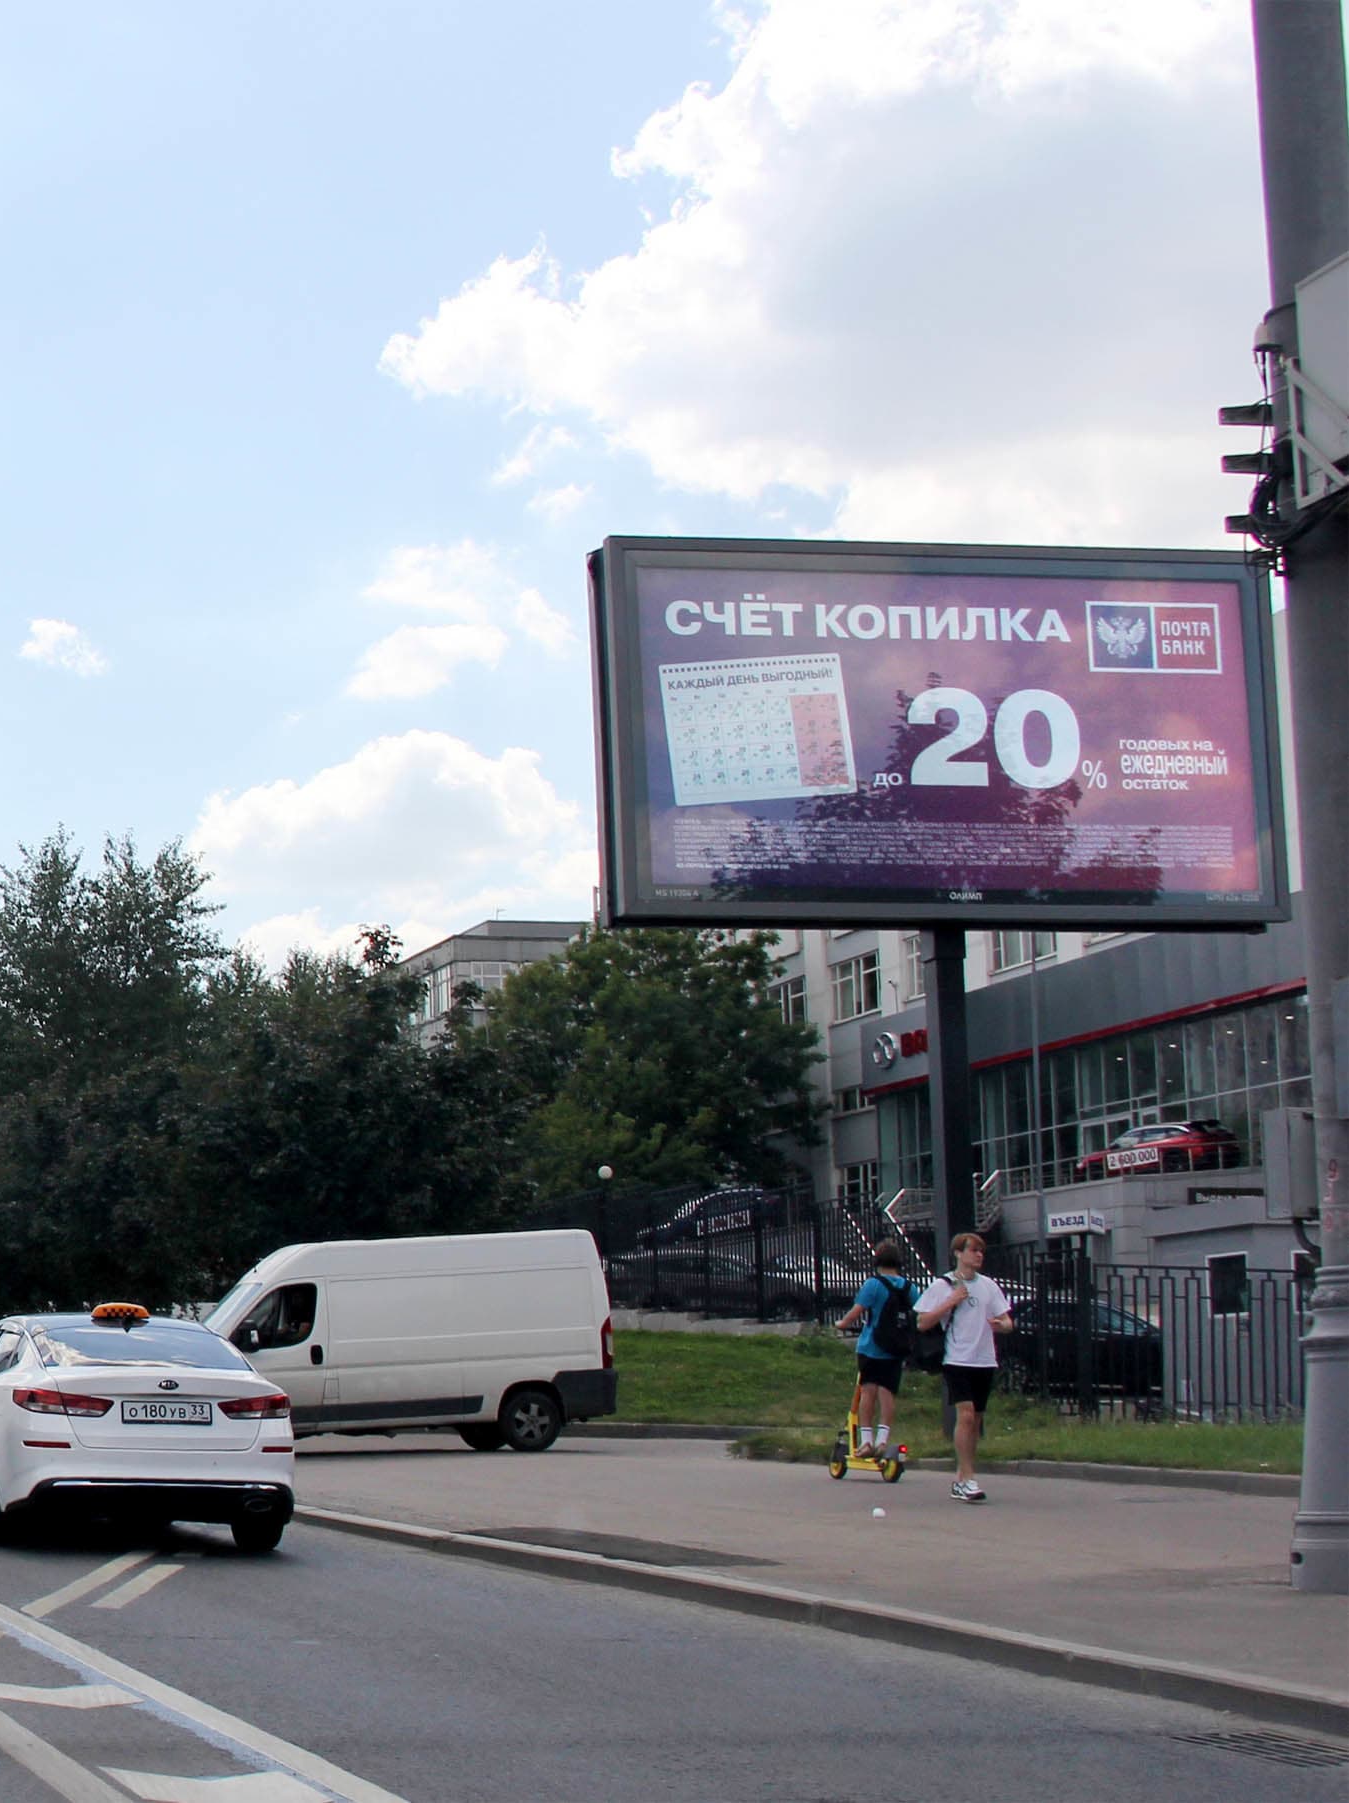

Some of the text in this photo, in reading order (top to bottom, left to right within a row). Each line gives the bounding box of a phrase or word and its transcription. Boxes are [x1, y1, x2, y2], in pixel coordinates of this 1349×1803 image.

[665, 593, 1071, 642] СЧЁТ КОПИЛКА
[1160, 621, 1211, 637] ПОЧТА
[1162, 640, 1206, 655] БАНК
[667, 668, 833, 690] КАЖДЫЙ ДЕНЬ ВЫГОДНЫЙ!
[1119, 739, 1214, 752] годовых на
[1120, 749, 1228, 778] ежедневный
[1122, 779, 1189, 790] остаток
[1051, 1215, 1085, 1227] ВЪЕЗД
